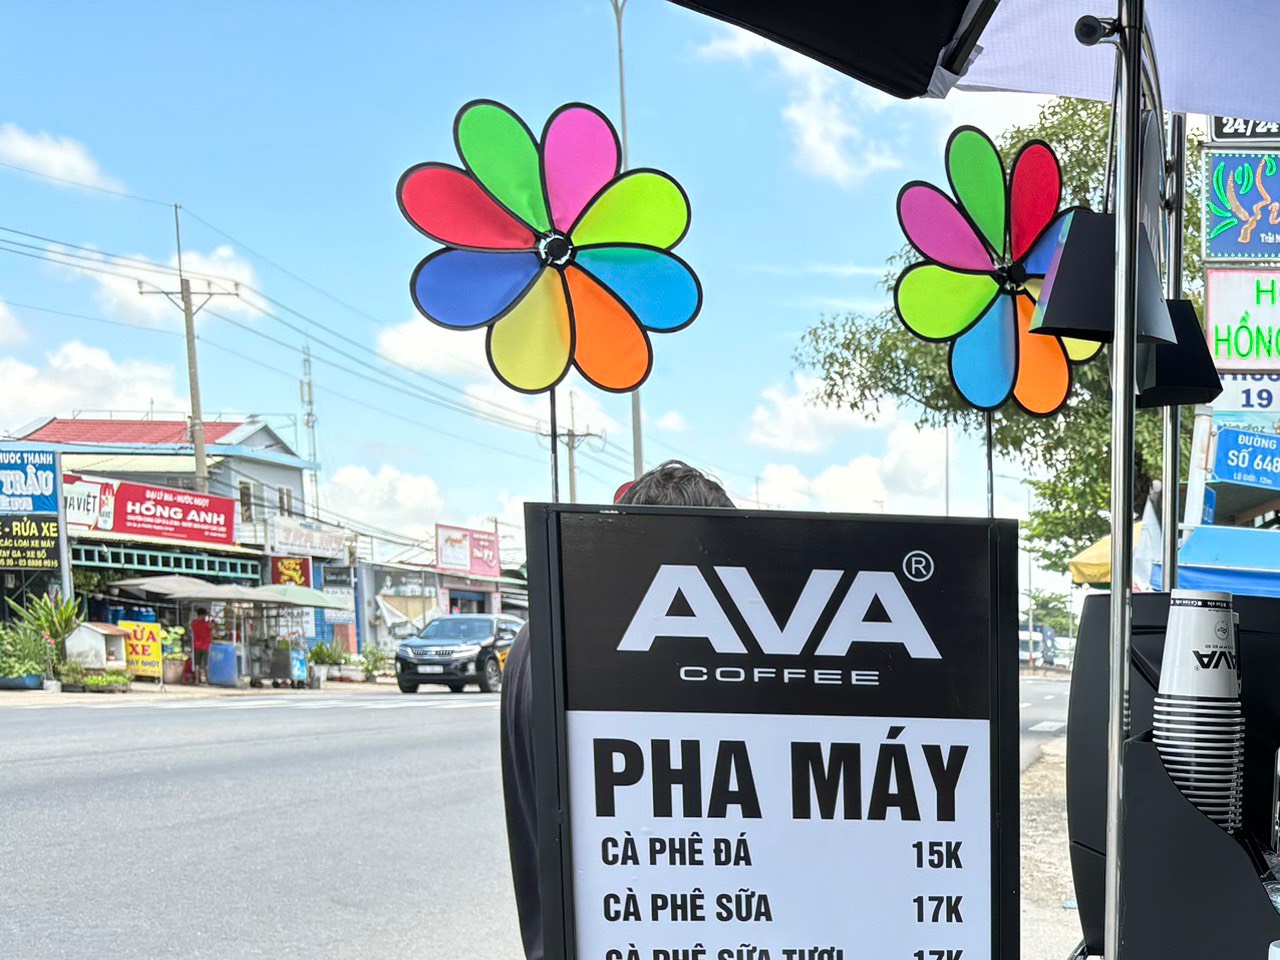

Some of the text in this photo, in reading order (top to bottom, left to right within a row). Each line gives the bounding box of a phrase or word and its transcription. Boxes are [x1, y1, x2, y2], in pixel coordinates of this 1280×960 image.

[1241, 388, 1273, 408] 19
[1238, 433, 1277, 450] ĐƯỜNG
[23, 452, 53, 467] THẠNH
[1227, 447, 1253, 468] SỐ
[1, 464, 54, 496] TRÂU
[77, 492, 98, 515] VIỆT
[12, 516, 58, 537] RỬA XE
[186, 509, 225, 525] ANH
[616, 564, 943, 660] AVA
[129, 644, 151, 656] XE
[679, 666, 880, 686] COFFEE
[592, 725, 970, 822] PHA MÁY
[601, 831, 963, 869] CÀ PHÊ ĐÁ 15K
[603, 887, 963, 923] CÀ PHÊ SỮA 17K
